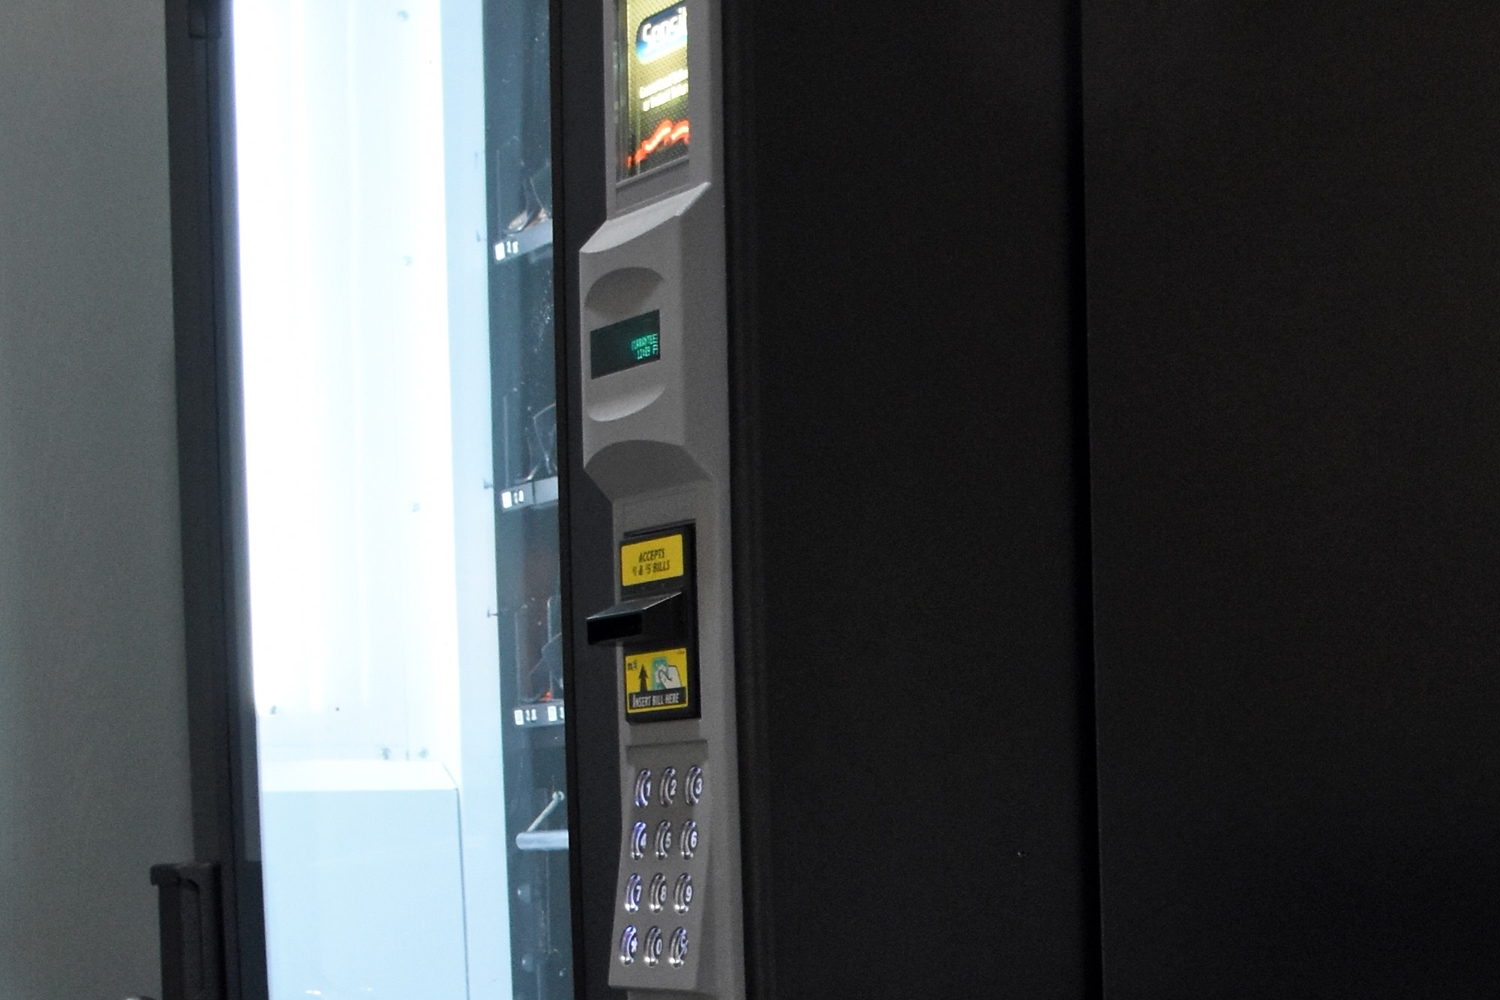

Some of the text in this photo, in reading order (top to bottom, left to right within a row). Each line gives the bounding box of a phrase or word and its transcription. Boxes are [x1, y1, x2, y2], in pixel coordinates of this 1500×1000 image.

[638, 548, 665, 562] ACCEPTS
[653, 560, 670, 573] BILLS
[632, 692, 680, 708] INSERT BILL HERE
[646, 778, 703, 797] 1 2 3
[690, 831, 698, 848] 6
[660, 885, 667, 902] 8
[685, 885, 693, 903] 9
